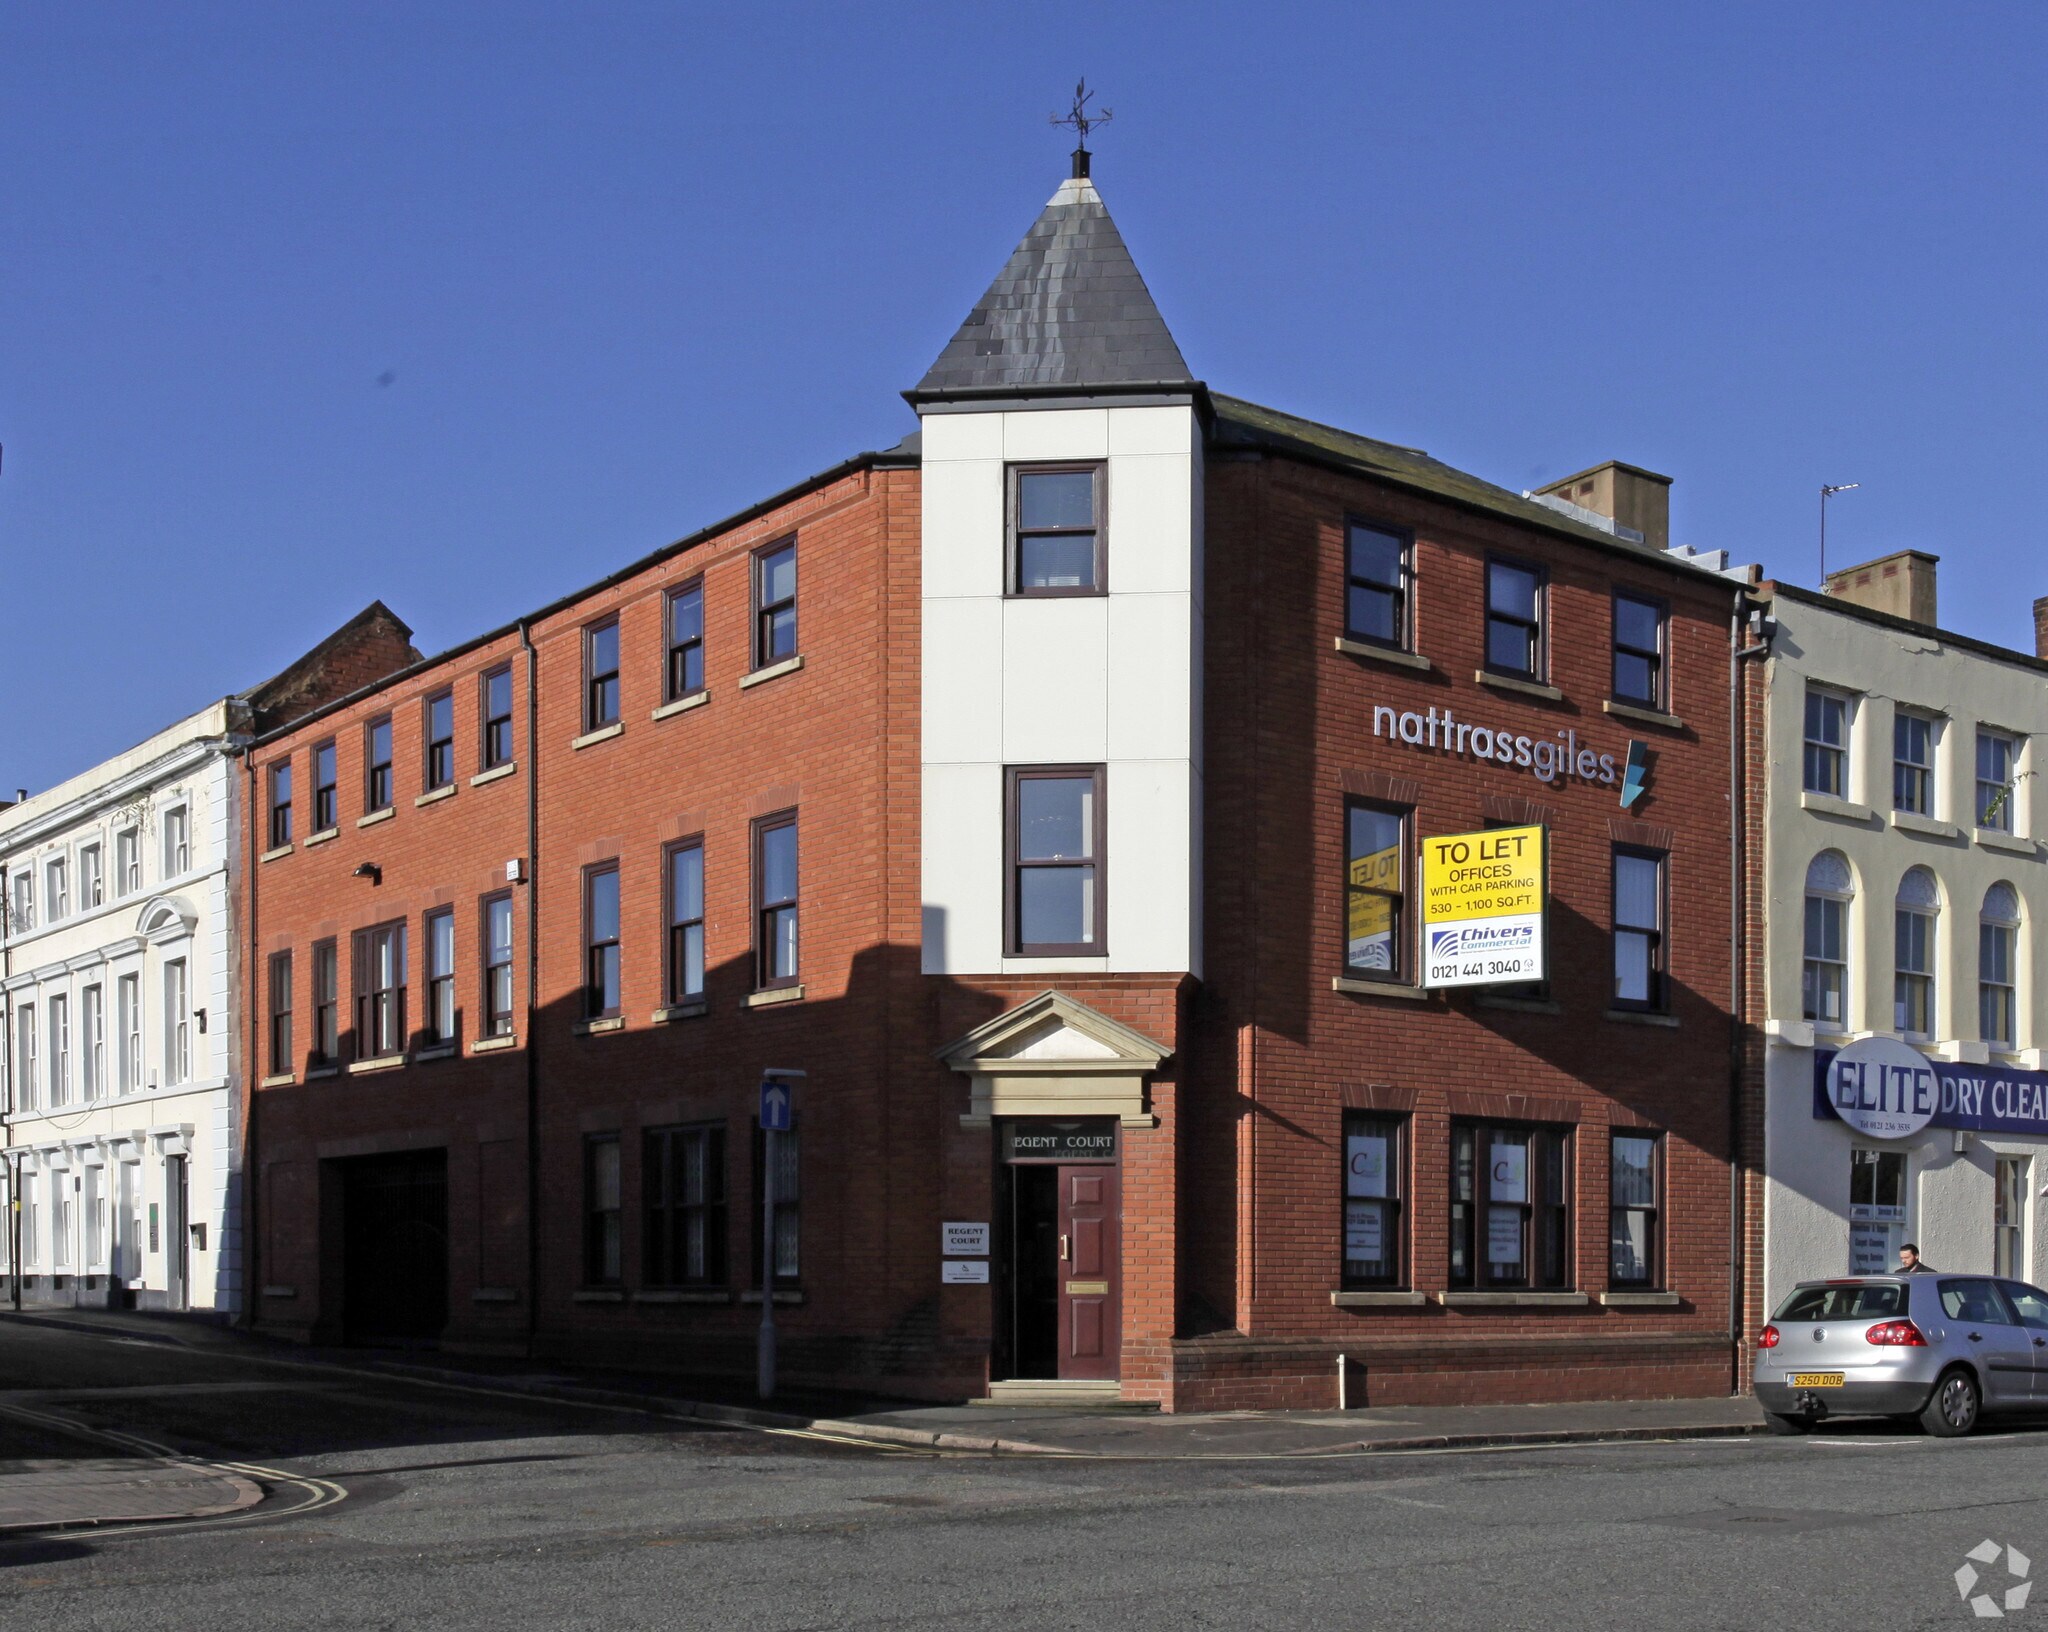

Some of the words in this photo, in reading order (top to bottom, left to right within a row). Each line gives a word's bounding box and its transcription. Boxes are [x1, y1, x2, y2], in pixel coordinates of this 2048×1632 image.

[1435, 842, 1470, 865] TO
[1480, 835, 1528, 860] LET
[1449, 864, 1512, 882] OFFICES
[1430, 886, 1457, 896] WITH
[1460, 882, 1482, 893] CAR
[1486, 878, 1534, 891] PARKING
[1430, 902, 1452, 914] 530
[1466, 898, 1493, 911] 1,100
[1460, 926, 1533, 941] Chivers
[1460, 936, 1532, 950] Commercial
[1432, 964, 1458, 979] 0121
[1462, 962, 1483, 976] 441
[1488, 959, 1521, 975] 3040
[1836, 1060, 1932, 1116] ELITE
[1941, 1077, 1986, 1116] DRY
[1991, 1080, 2048, 1120] CLEA
[1066, 1136, 1113, 1148] COURT
[950, 1237, 981, 1245] COURT
[1794, 1375, 1820, 1386] S250
[1822, 1375, 1843, 1386] DOB
